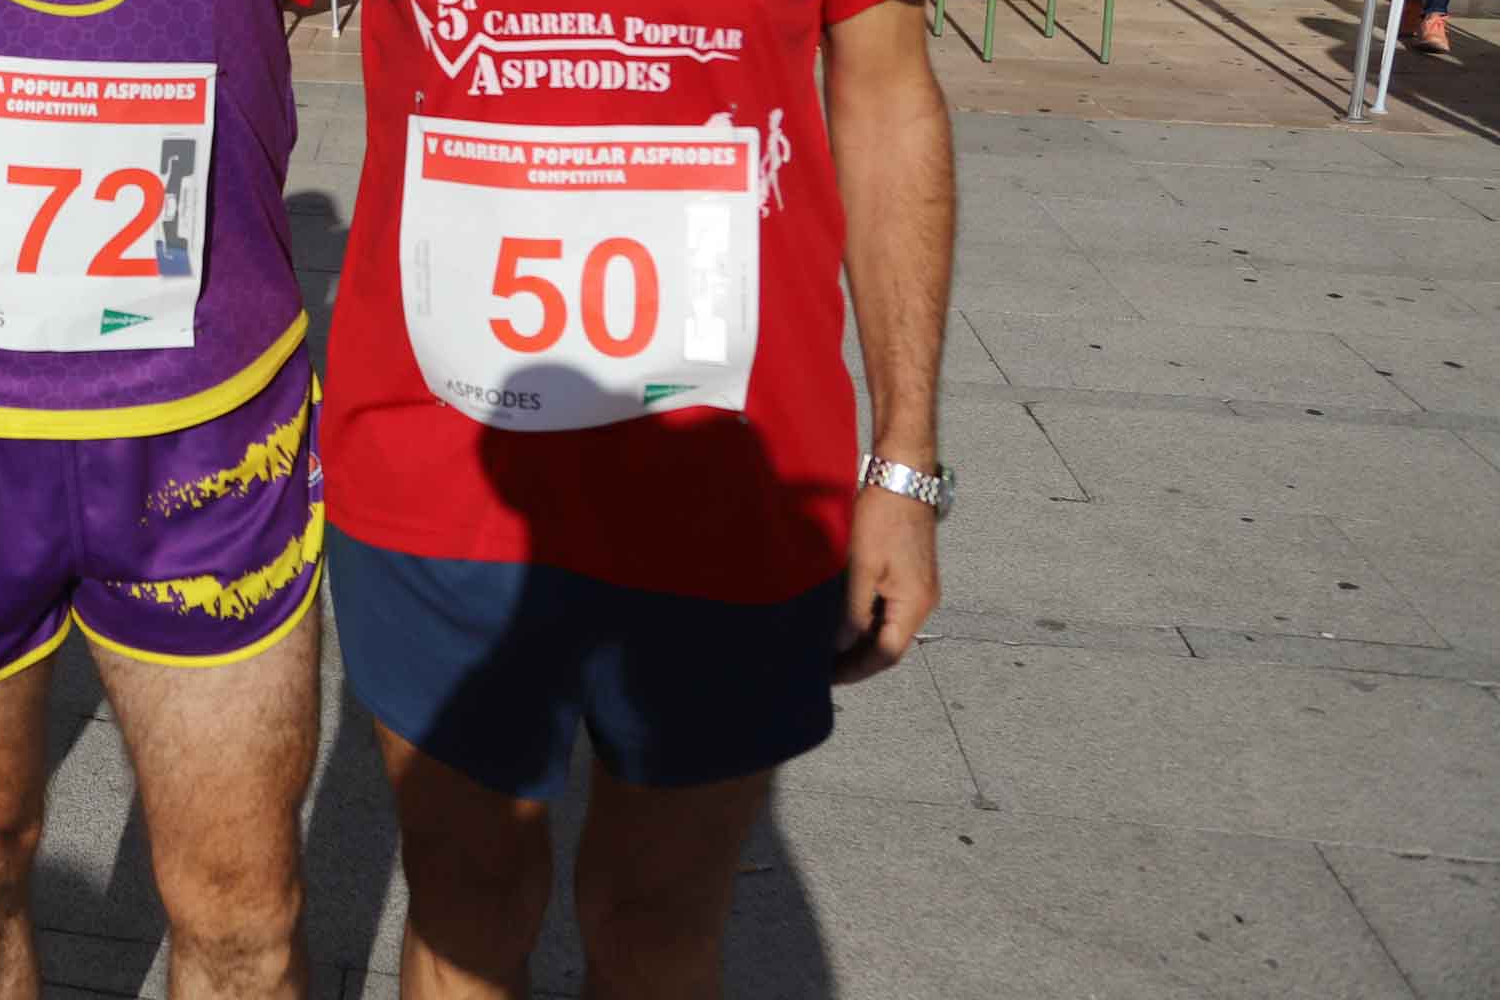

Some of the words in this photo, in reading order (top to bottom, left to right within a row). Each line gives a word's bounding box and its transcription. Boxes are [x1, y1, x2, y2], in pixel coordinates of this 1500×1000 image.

[483, 11, 615, 36] CARRERA
[624, 17, 742, 50] POPULAR
[11, 77, 99, 100] POPULAR
[104, 80, 197, 101] ASPRODES
[468, 53, 671, 96] ASPRODES
[6, 99, 98, 117] COMPETITIVA
[443, 139, 527, 164] CARRERA
[531, 146, 626, 165] POPULAR
[631, 146, 737, 166] ASPRODES
[527, 168, 627, 184] COMPETITIVA
[488, 236, 660, 359] 50
[445, 378, 542, 411] ASPRODES
